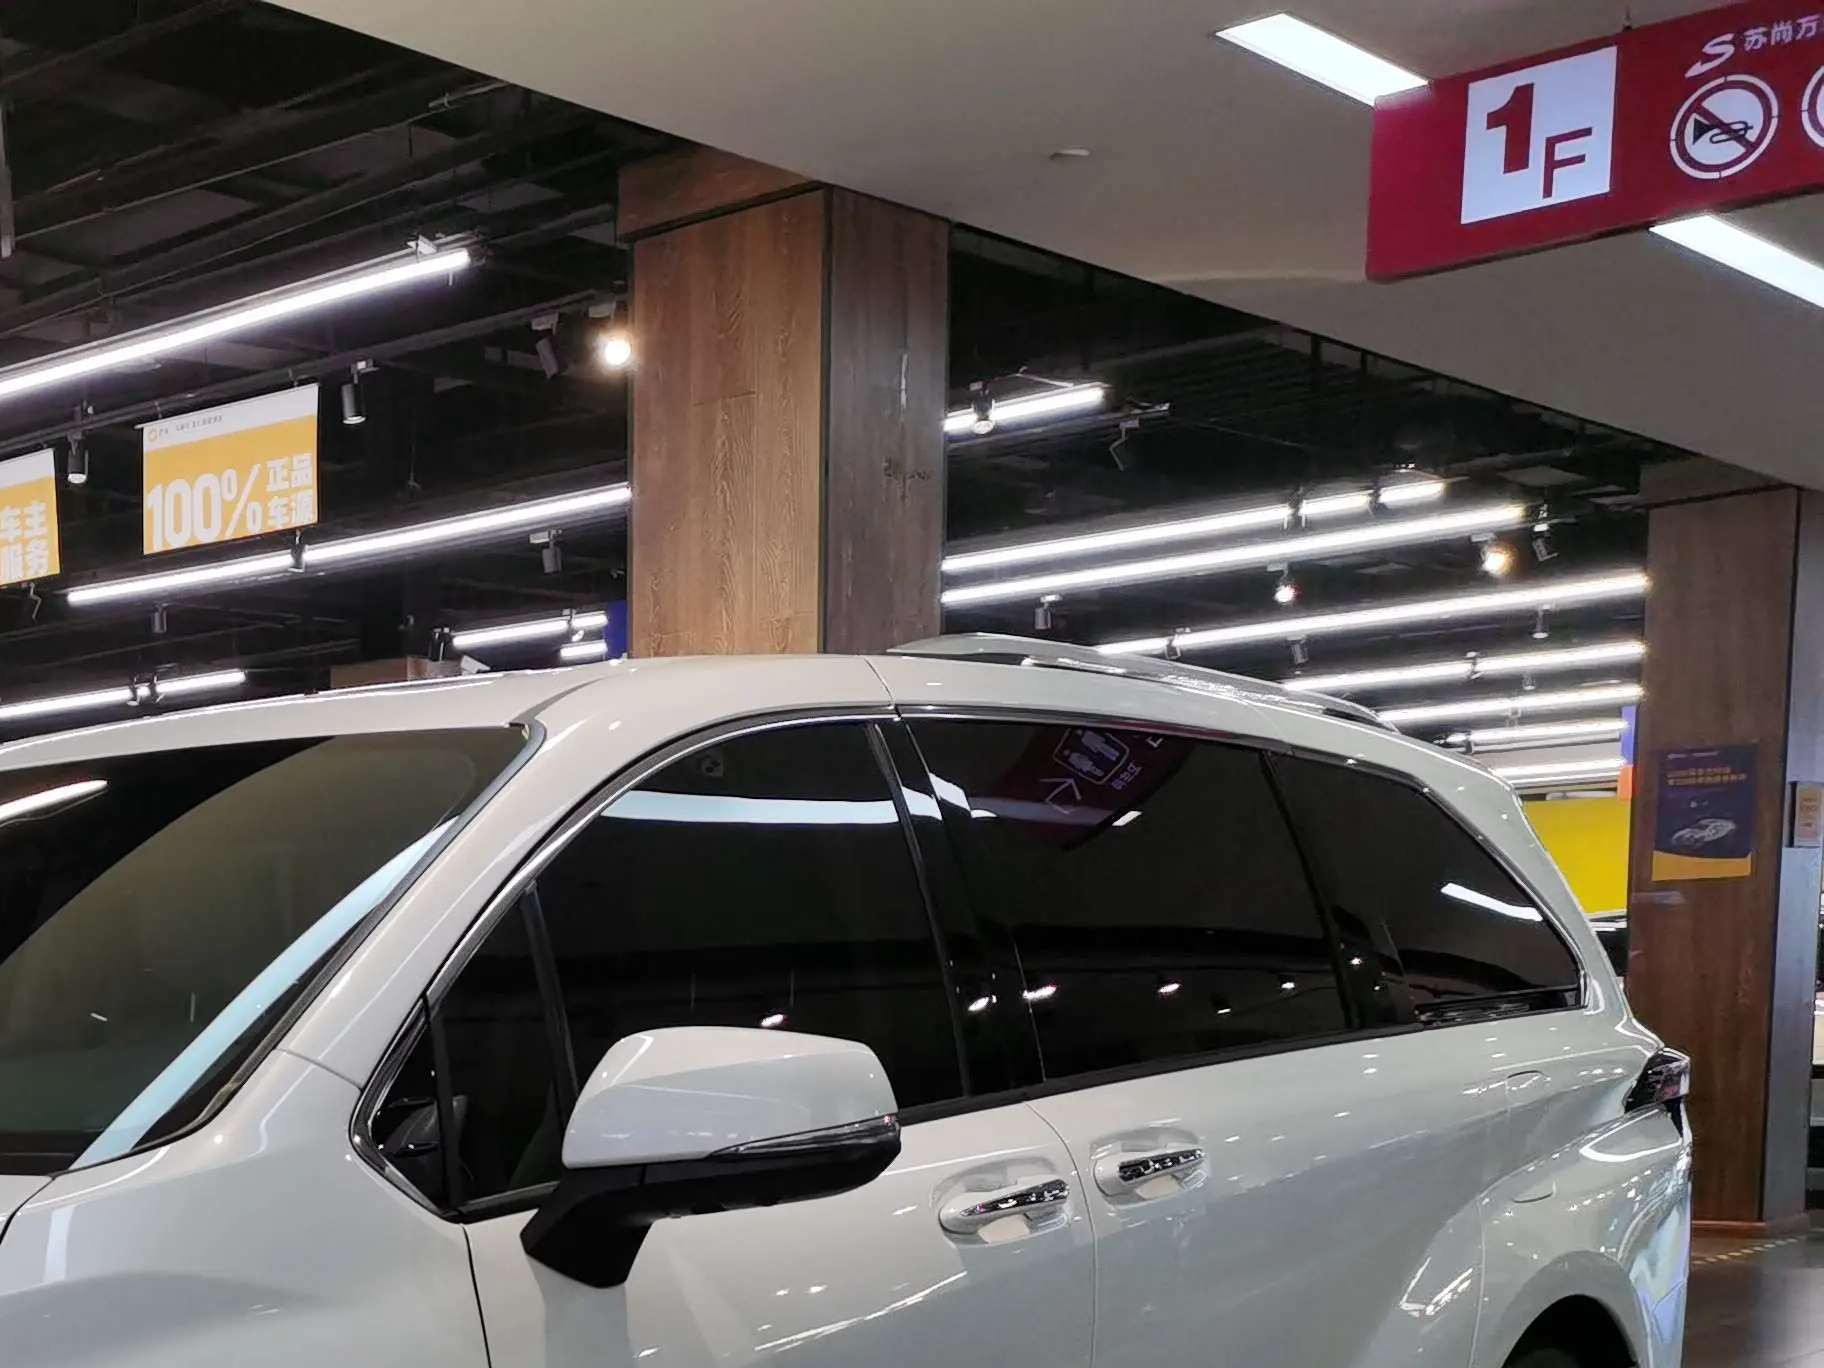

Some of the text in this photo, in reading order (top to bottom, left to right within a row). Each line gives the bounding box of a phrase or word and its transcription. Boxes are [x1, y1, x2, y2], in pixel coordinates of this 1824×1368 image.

[266, 453, 313, 492] 正品
[147, 464, 263, 553] 100%
[267, 490, 314, 530] 车源
